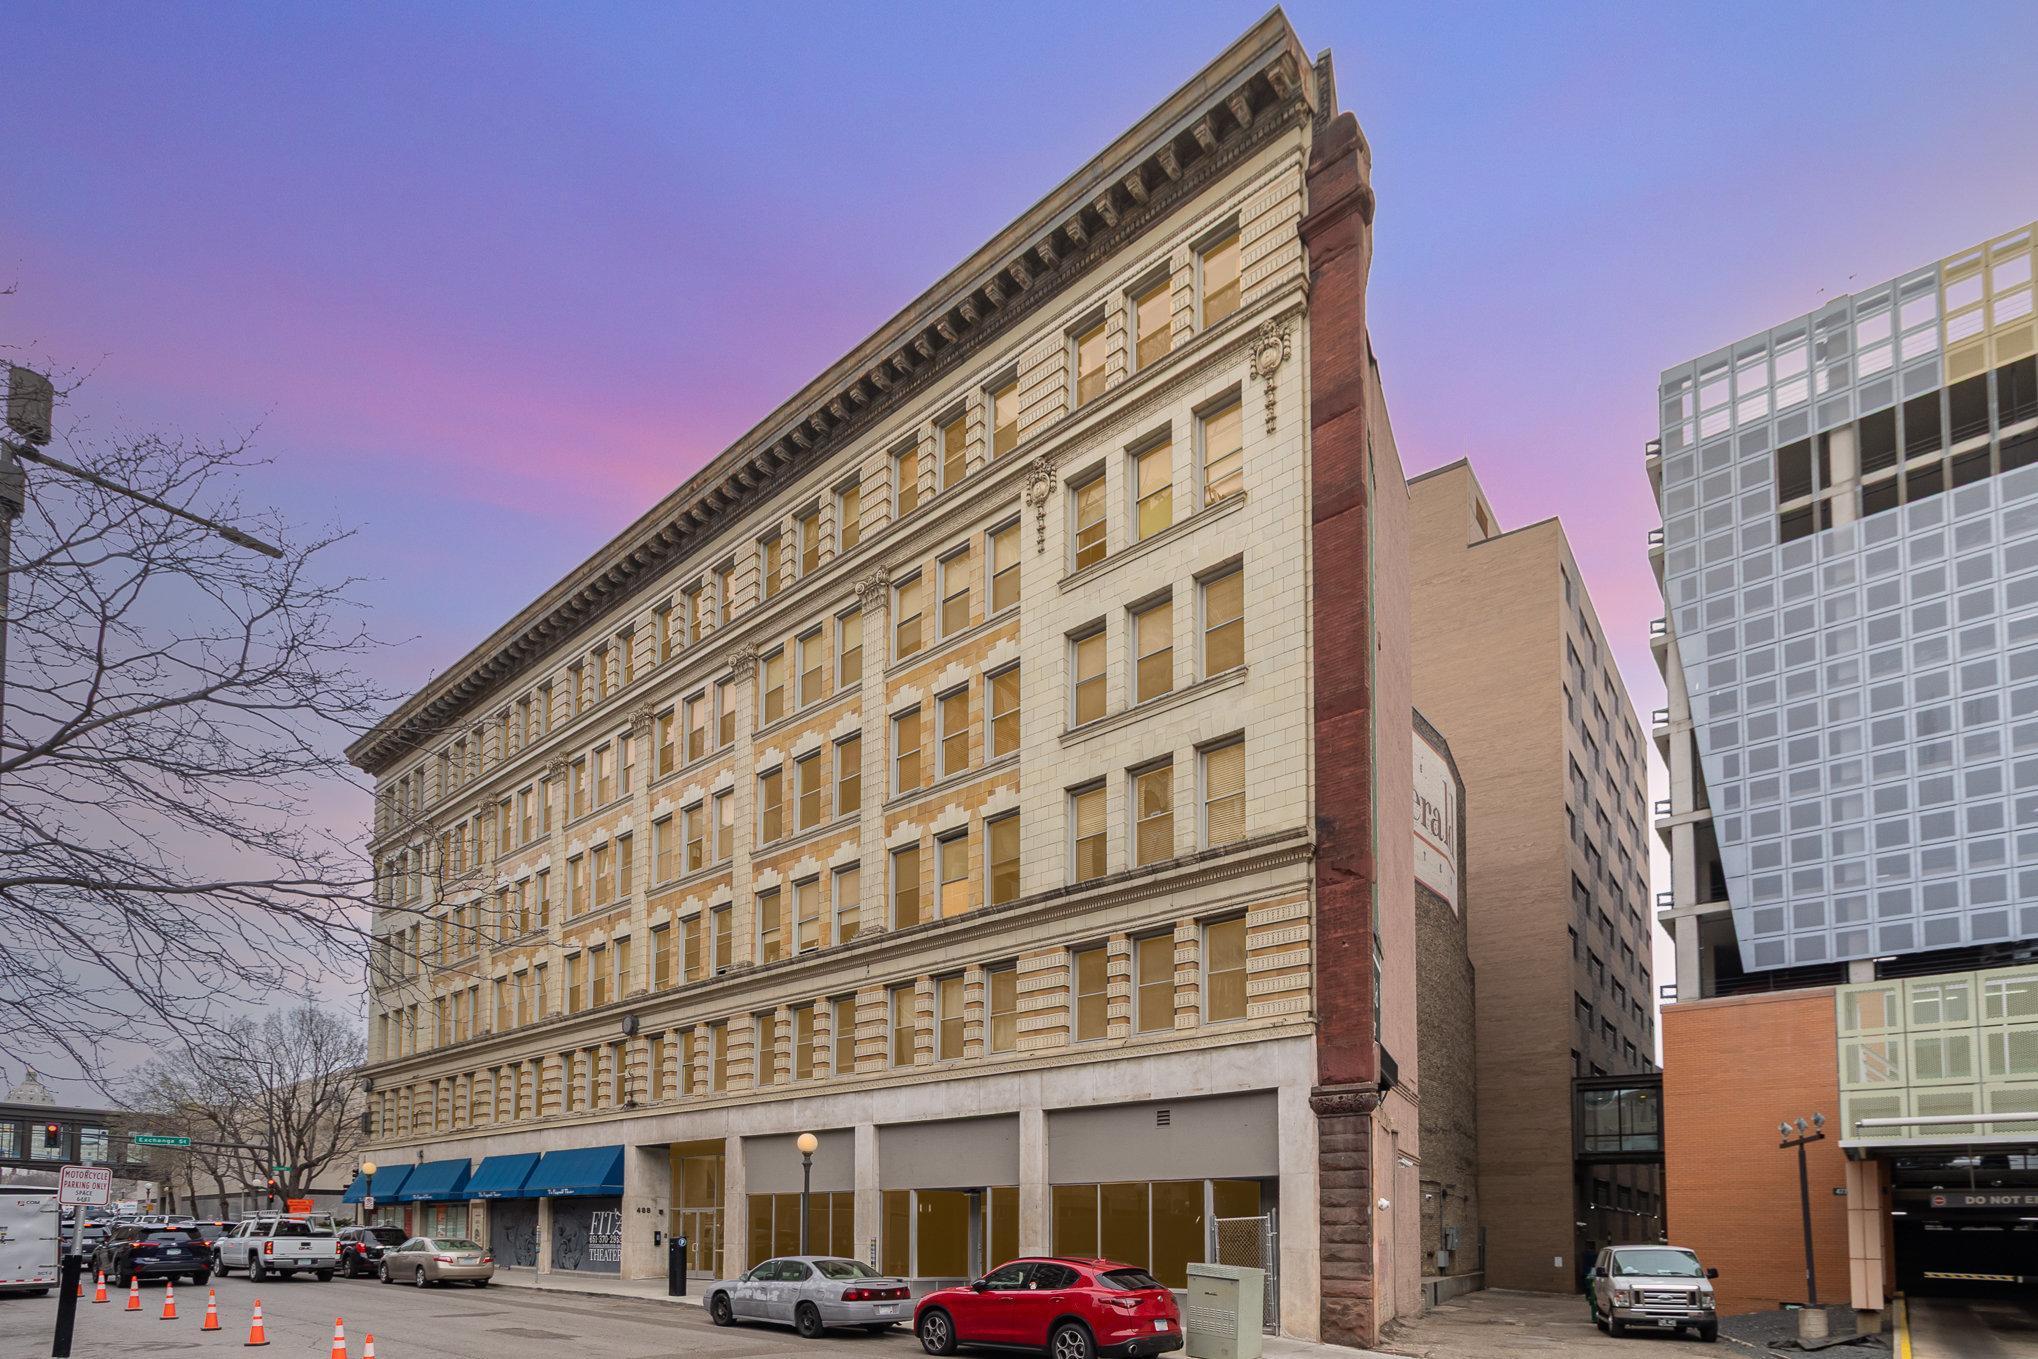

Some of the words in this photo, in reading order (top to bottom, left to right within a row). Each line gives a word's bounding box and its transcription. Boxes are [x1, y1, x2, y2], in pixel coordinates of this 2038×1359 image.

[65, 1170, 108, 1180] MOTORCYCLE
[64, 1180, 90, 1189] PARKING
[92, 1182, 107, 1190] ONLY
[1965, 1196, 1986, 1204] DO
[1990, 1196, 2020, 1204] NOT
